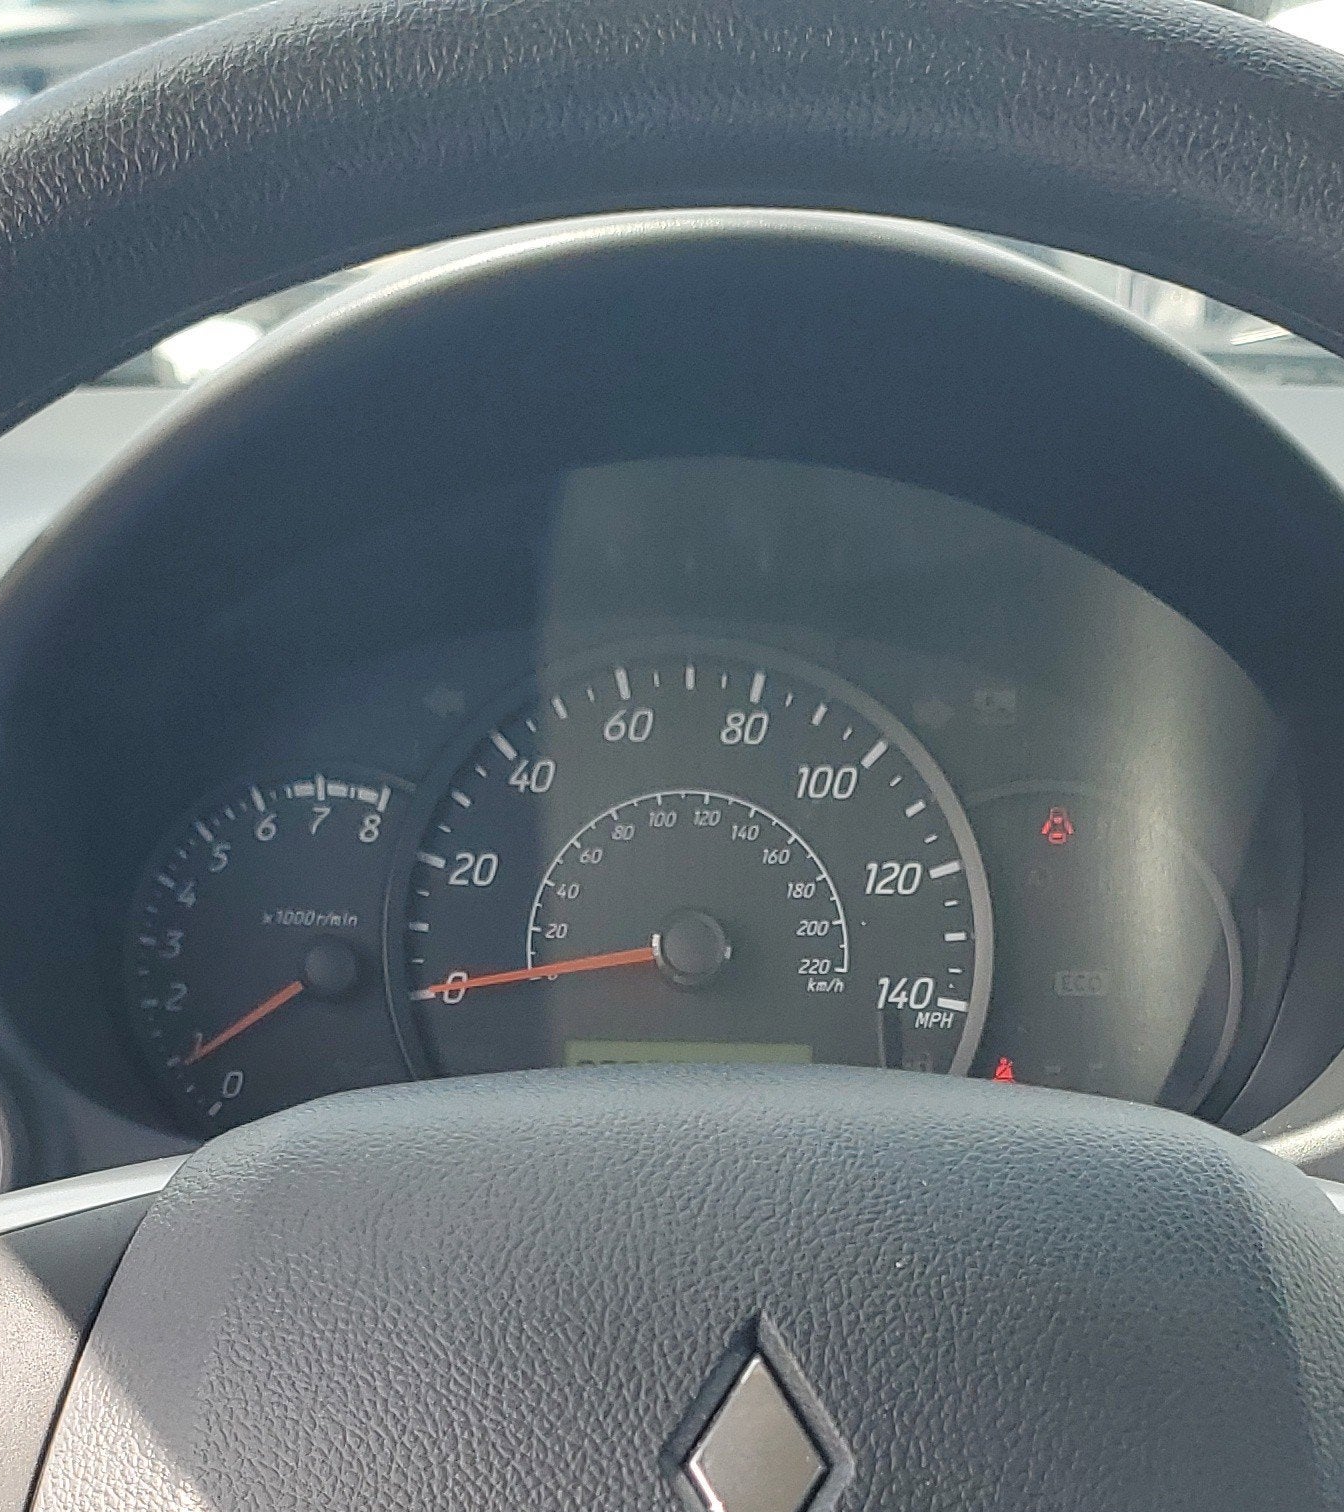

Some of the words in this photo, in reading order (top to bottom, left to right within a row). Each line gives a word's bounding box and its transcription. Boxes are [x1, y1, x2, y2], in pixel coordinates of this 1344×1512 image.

[604, 709, 654, 743] 60
[720, 711, 768, 745] 80
[509, 759, 556, 794] 40
[796, 765, 858, 800] 100
[255, 814, 277, 842] 6
[309, 806, 331, 835] 7
[358, 814, 381, 844] 8
[648, 810, 677, 829] 100
[692, 808, 722, 827] 120
[611, 823, 636, 842] 80
[730, 823, 761, 842] 140
[210, 843, 232, 873] 5
[579, 847, 603, 865] 60
[761, 847, 791, 866] 160
[449, 852, 499, 887] 20
[863, 861, 923, 896] 120
[557, 881, 581, 900] 40
[786, 881, 816, 900] 180
[544, 922, 569, 940] 20
[796, 918, 830, 937] 200
[798, 958, 832, 976] 220
[442, 971, 470, 1005] 0
[806, 977, 845, 995] km/h
[875, 976, 934, 1010] 140
[914, 1009, 955, 1031] MPH
[222, 1071, 244, 1099] 0
